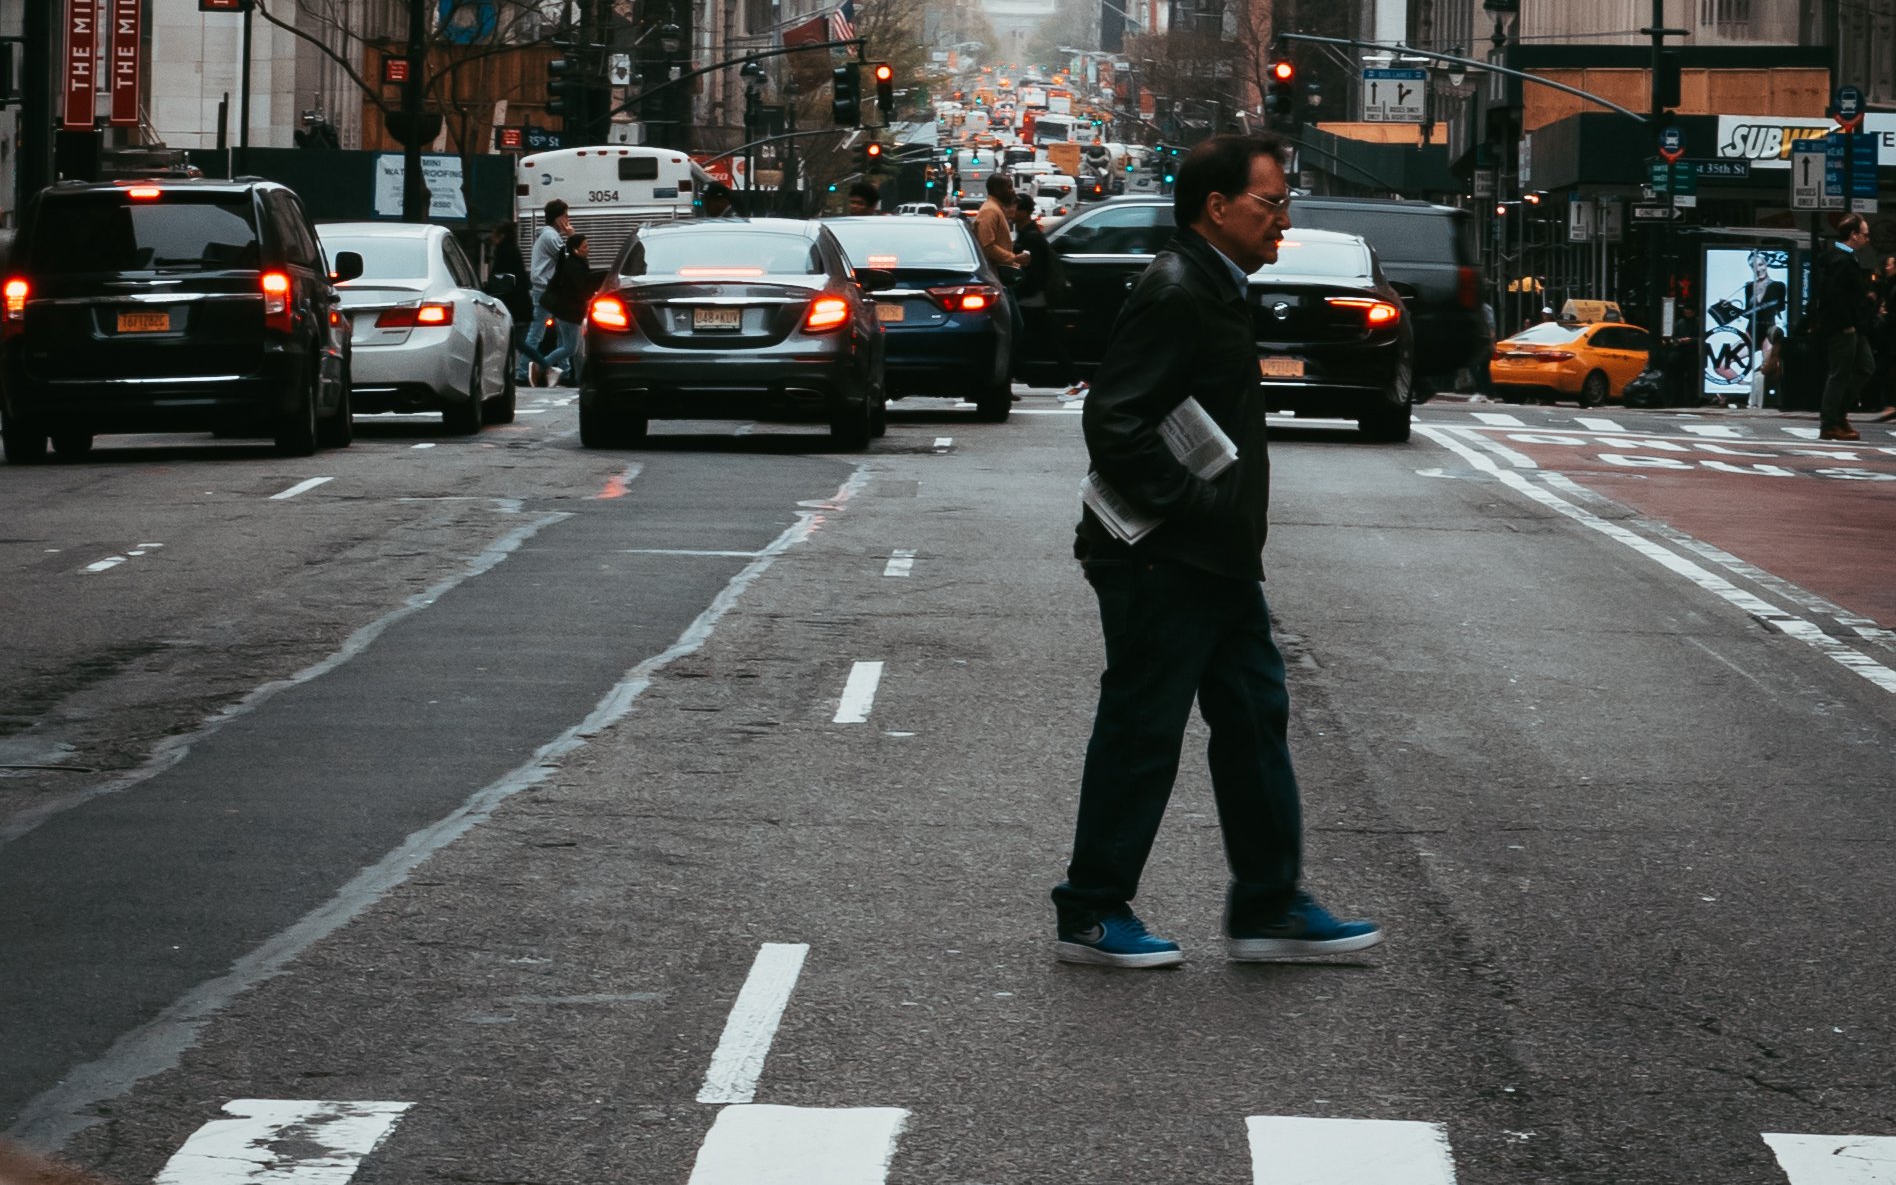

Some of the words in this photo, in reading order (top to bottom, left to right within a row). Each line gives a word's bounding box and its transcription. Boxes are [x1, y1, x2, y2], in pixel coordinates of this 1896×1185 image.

[72, 47, 90, 91] THE
[117, 47, 134, 89] THE
[1706, 163, 1731, 175] 35th
[1733, 163, 1746, 175] St
[588, 190, 620, 203] 3054
[1705, 343, 1748, 370] MK
